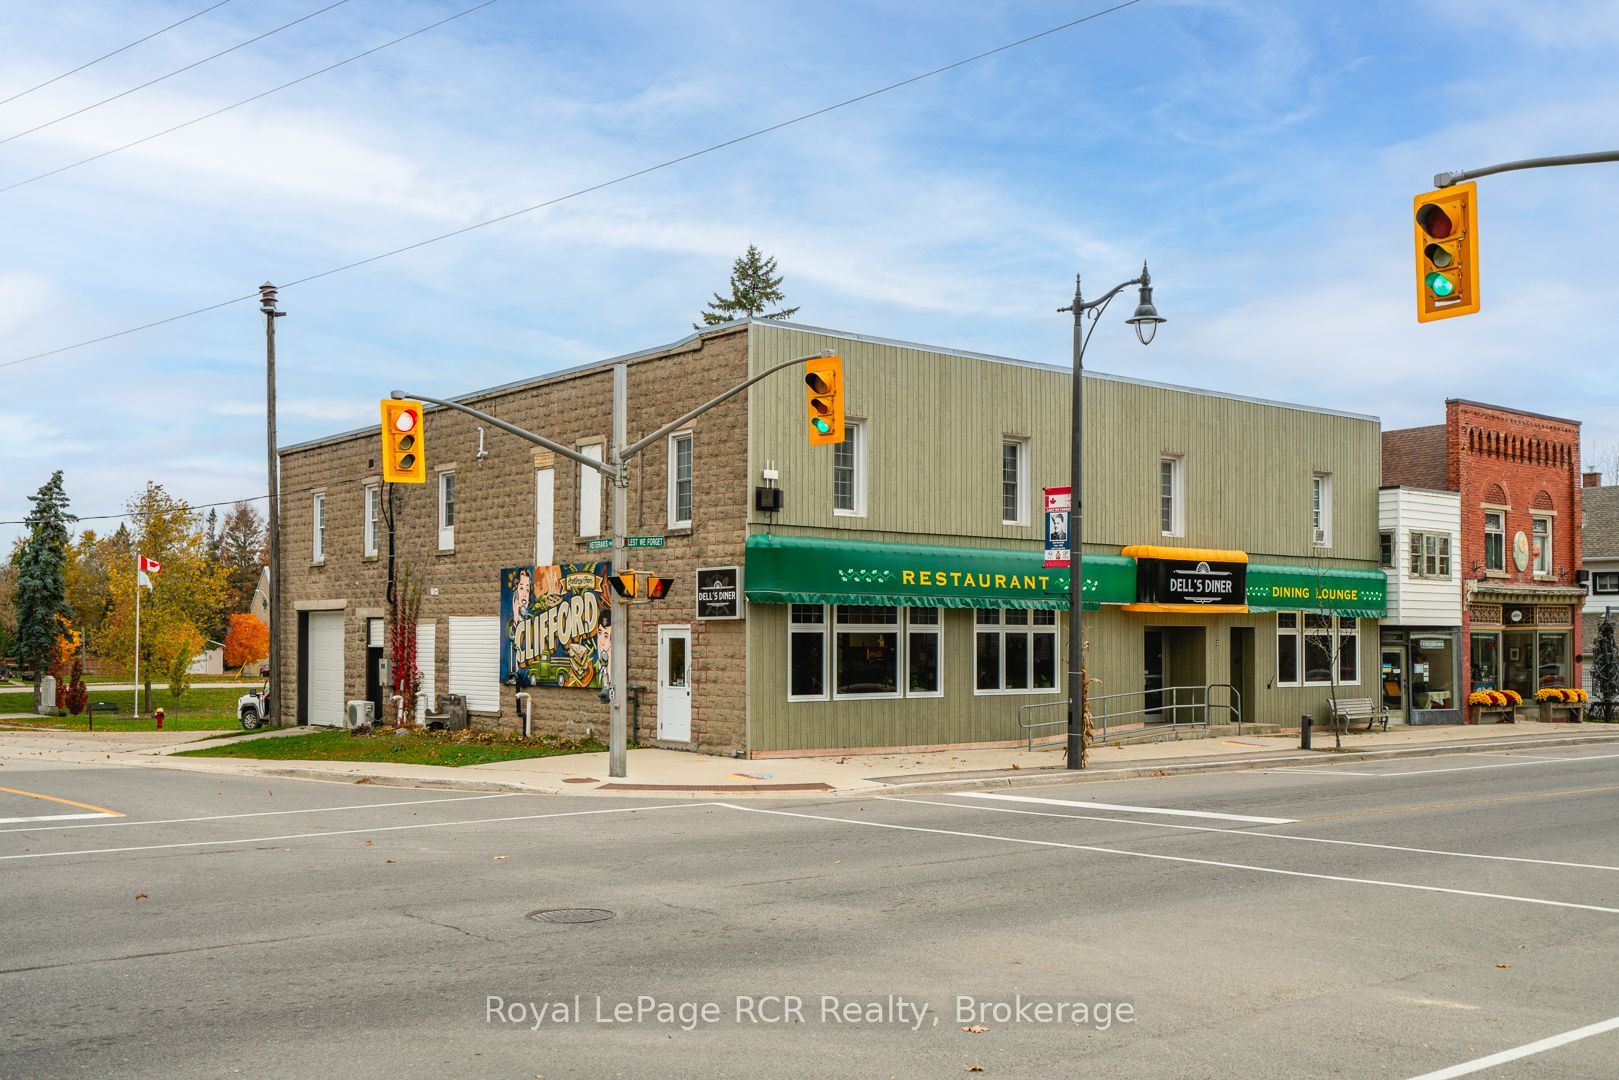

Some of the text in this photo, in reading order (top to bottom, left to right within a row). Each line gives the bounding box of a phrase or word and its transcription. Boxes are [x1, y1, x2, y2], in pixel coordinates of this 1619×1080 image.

[628, 537, 663, 546] LEST WE FORGET
[902, 569, 1050, 590] RESTAURANT
[1170, 578, 1232, 593] DELL'S DINER
[698, 591, 736, 601] DELL'S DINER
[1272, 586, 1358, 600] DINING LOUNGE
[514, 591, 598, 663] CLIFFORD
